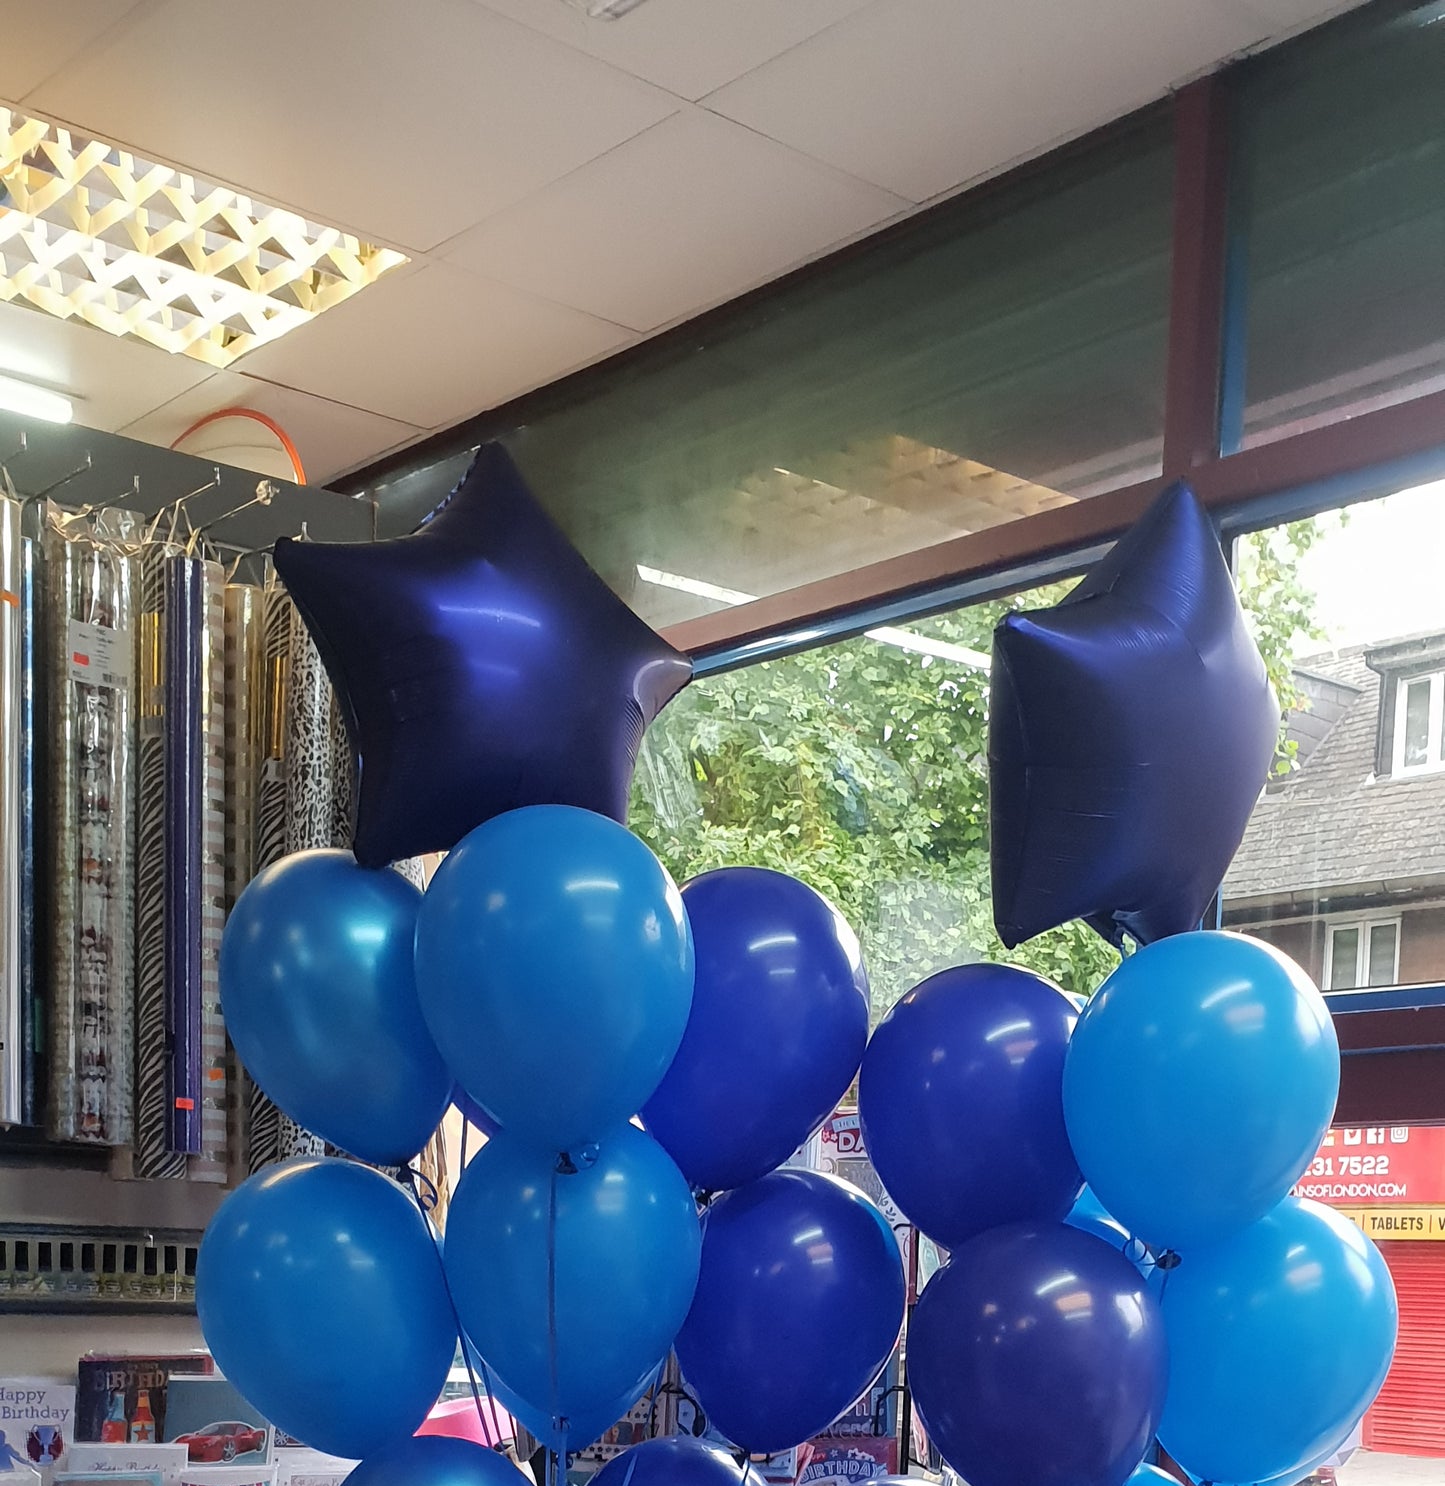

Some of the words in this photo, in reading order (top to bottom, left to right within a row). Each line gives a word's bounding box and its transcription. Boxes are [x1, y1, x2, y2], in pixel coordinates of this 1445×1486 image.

[1304, 1157, 1334, 1176] 31
[1338, 1155, 1389, 1175] 7522
[1293, 1183, 1406, 1197] AINSOFLONDON.COM
[1371, 1216, 1424, 1231] TABLETS
[94, 1369, 169, 1391] BIRTHD
[2, 1406, 70, 1422] Birthday
